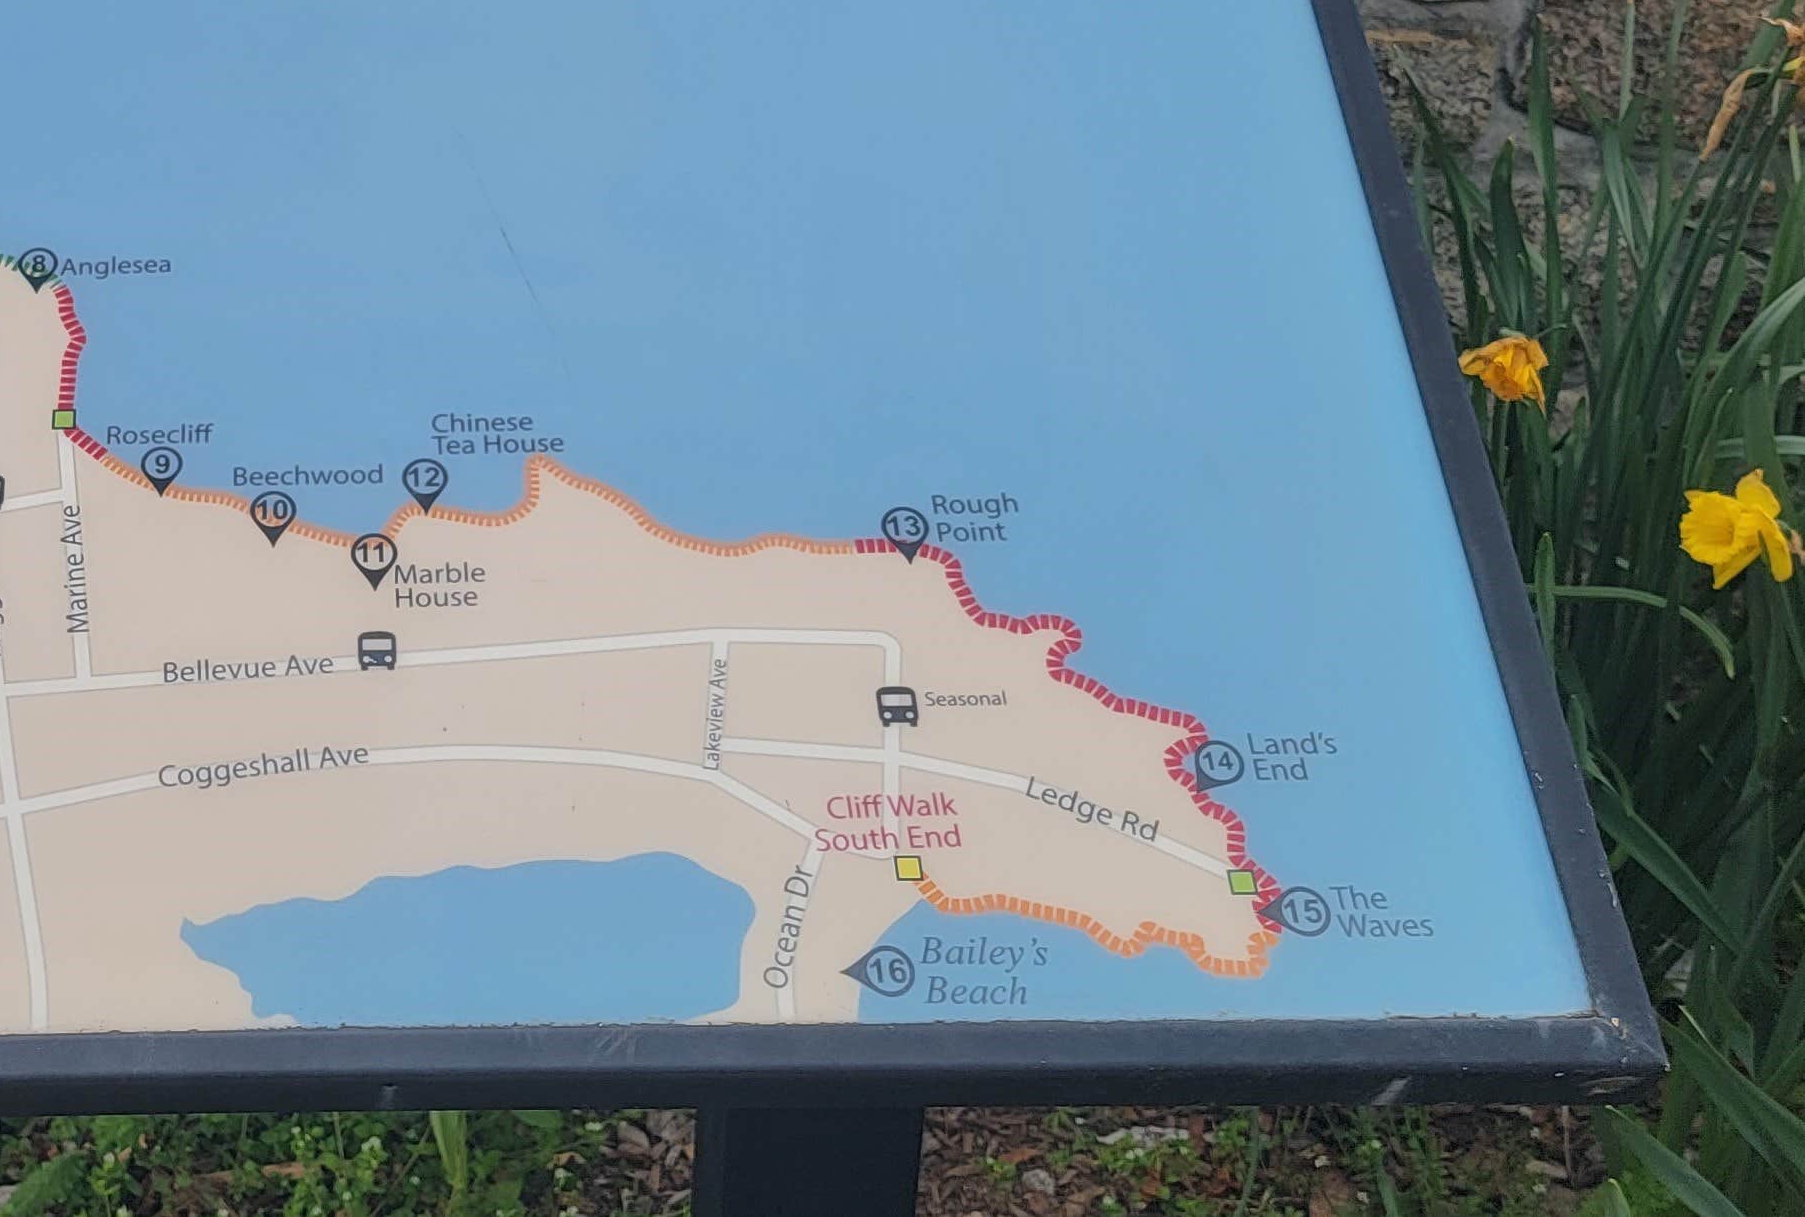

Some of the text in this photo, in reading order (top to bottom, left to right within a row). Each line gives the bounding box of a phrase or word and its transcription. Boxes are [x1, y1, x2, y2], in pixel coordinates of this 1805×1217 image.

[52, 254, 172, 278] Anglesea
[106, 422, 215, 445] Rosecliff
[430, 412, 534, 434] Chinese
[430, 434, 564, 455] Tea House
[232, 462, 383, 487] Beechwood
[930, 491, 1020, 518] Rough
[888, 514, 921, 537] 13
[935, 521, 1008, 543] Point
[61, 505, 89, 633] Marine Ave
[394, 562, 486, 585] Marble
[395, 587, 479, 609] House
[163, 655, 334, 683] Bellevue Ave
[924, 689, 1007, 707] Seasonal
[1246, 731, 1339, 755] Land's
[158, 746, 369, 789] Coggeshall Ave
[1201, 750, 1231, 771] 14
[1252, 756, 1309, 782] End
[826, 791, 958, 820] Cliff Walk
[1026, 777, 1159, 842] Ledge Rd
[814, 823, 963, 853] South End
[1330, 884, 1388, 912] The
[1283, 900, 1322, 923] 15
[763, 864, 810, 989] Ocean Dr
[1335, 913, 1435, 938] Waves
[919, 936, 1048, 970] Bailey's
[869, 959, 906, 984] 16
[923, 975, 1028, 1006] Beach
